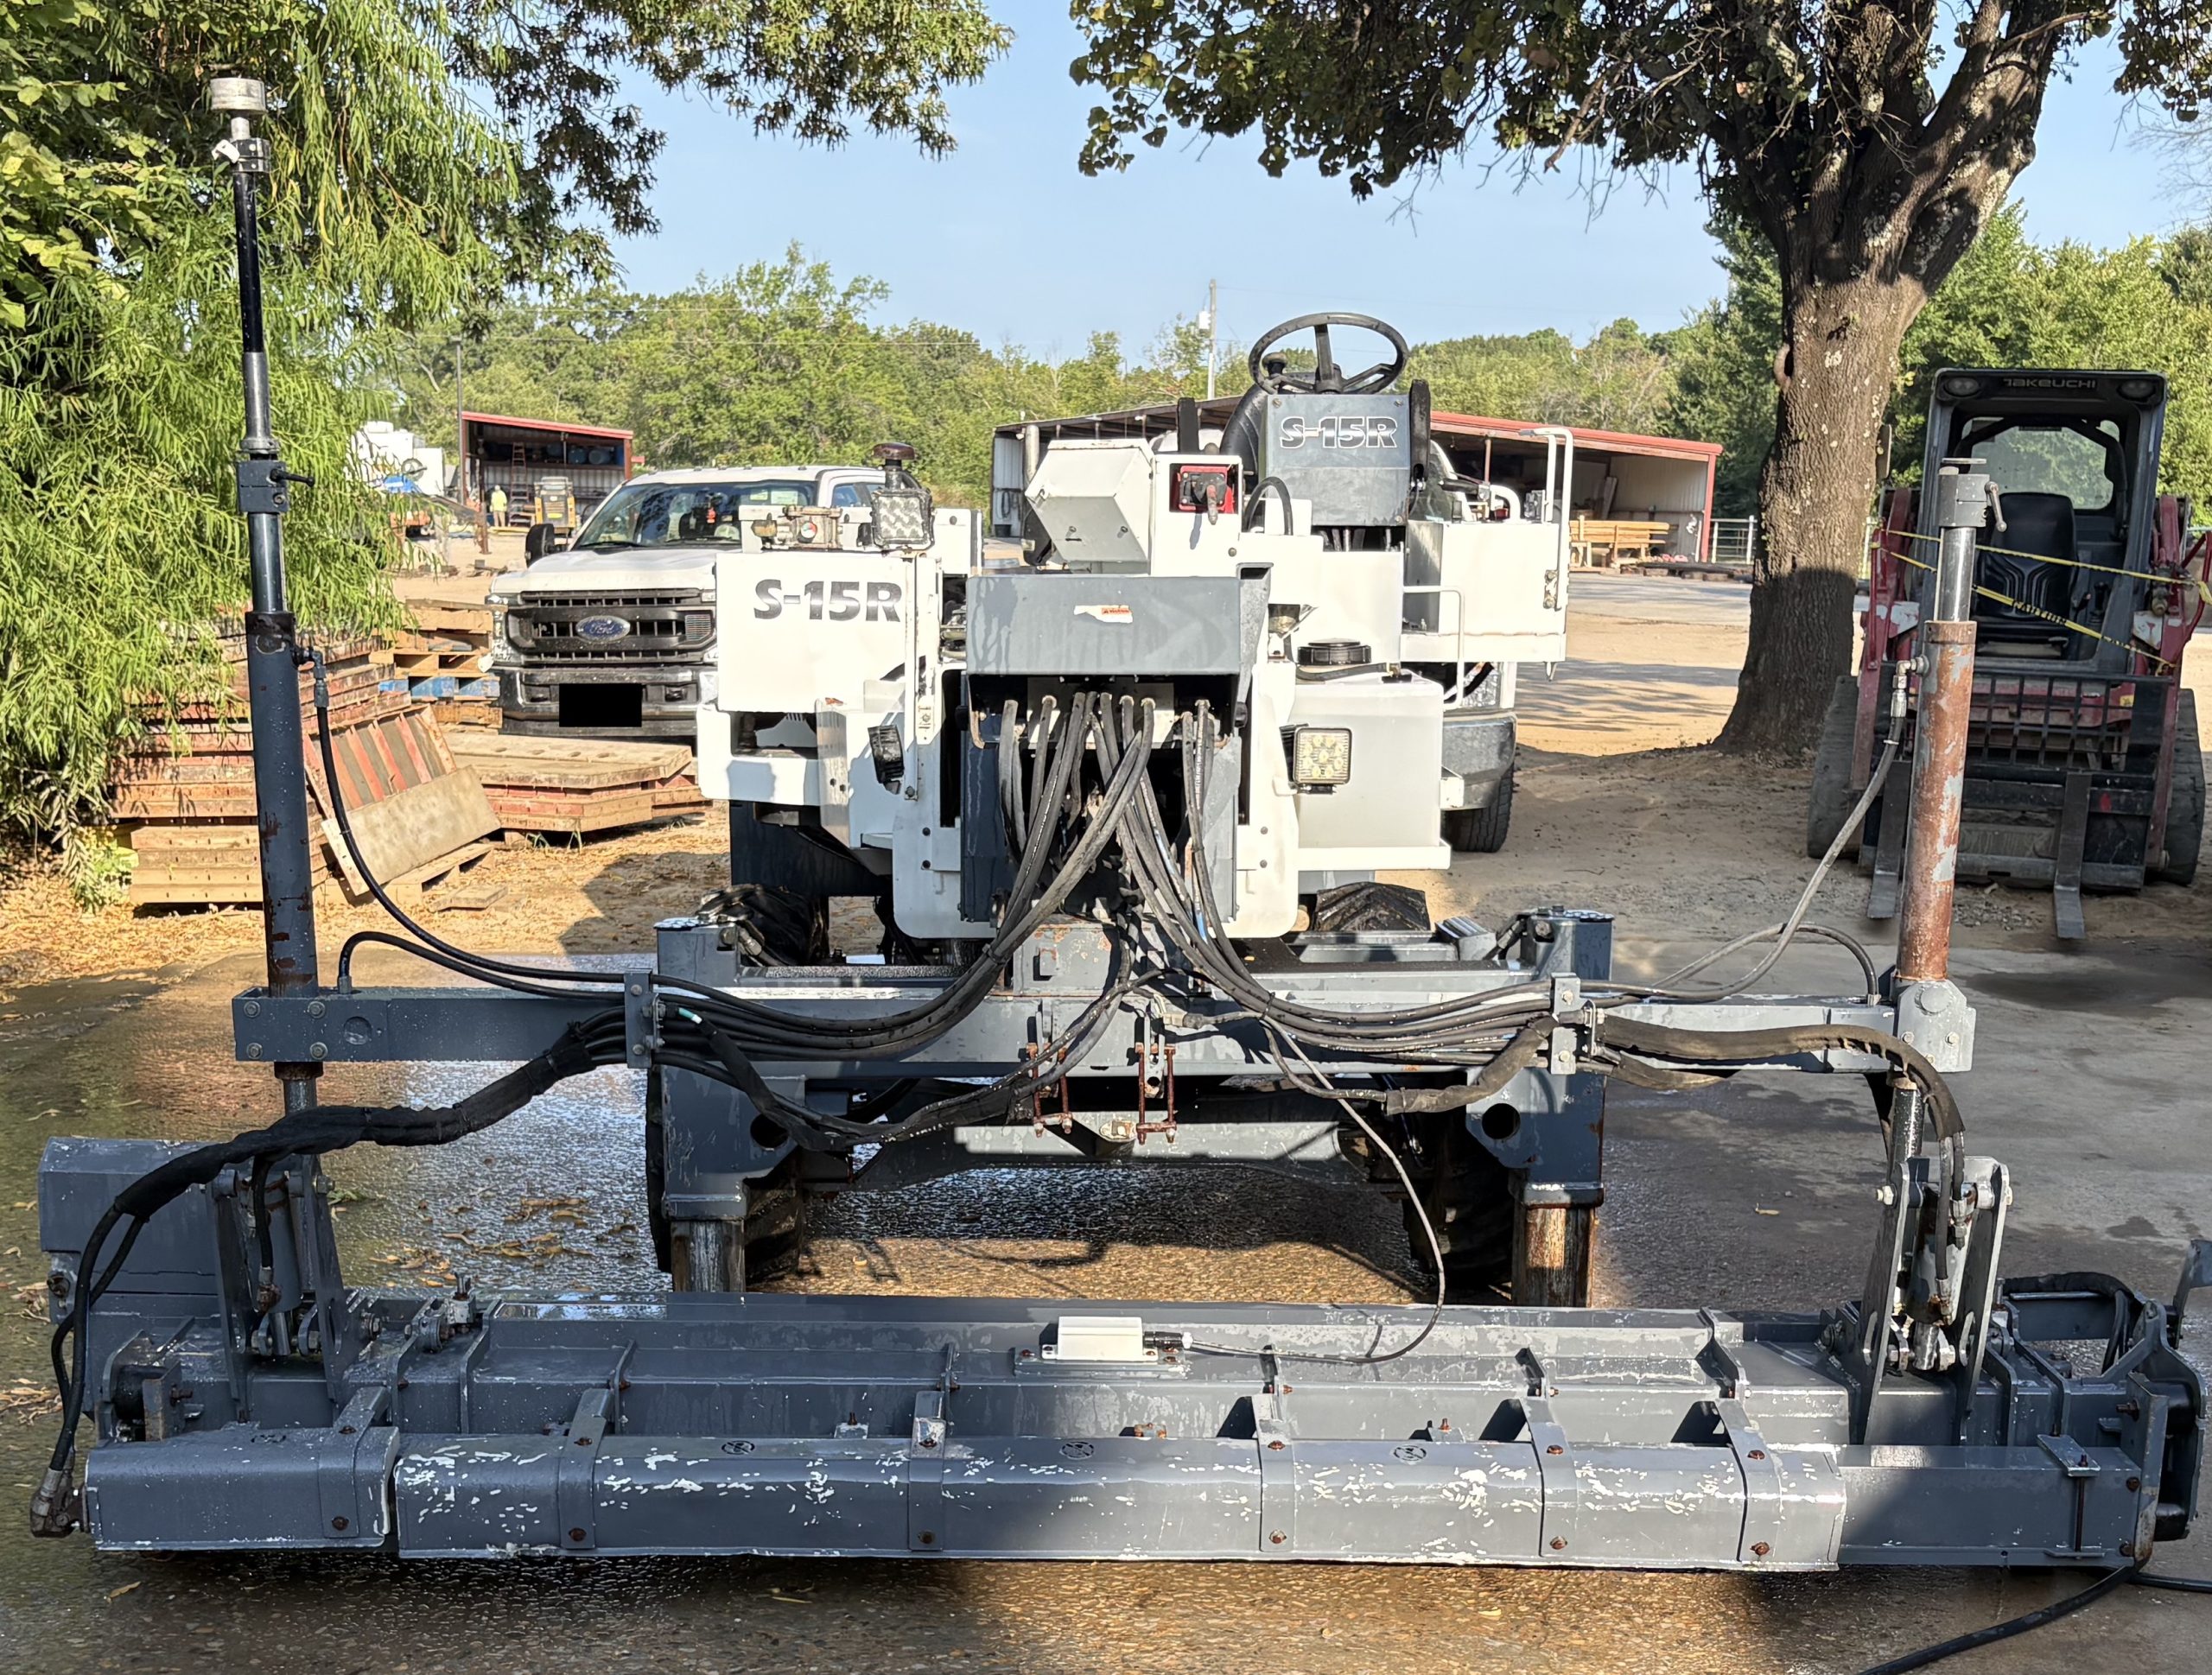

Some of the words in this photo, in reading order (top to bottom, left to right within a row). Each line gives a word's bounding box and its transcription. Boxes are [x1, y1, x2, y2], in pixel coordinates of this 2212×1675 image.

[1279, 416, 1398, 449] S-15R
[753, 579, 902, 622] S-15R
[589, 621, 615, 634] Ford
